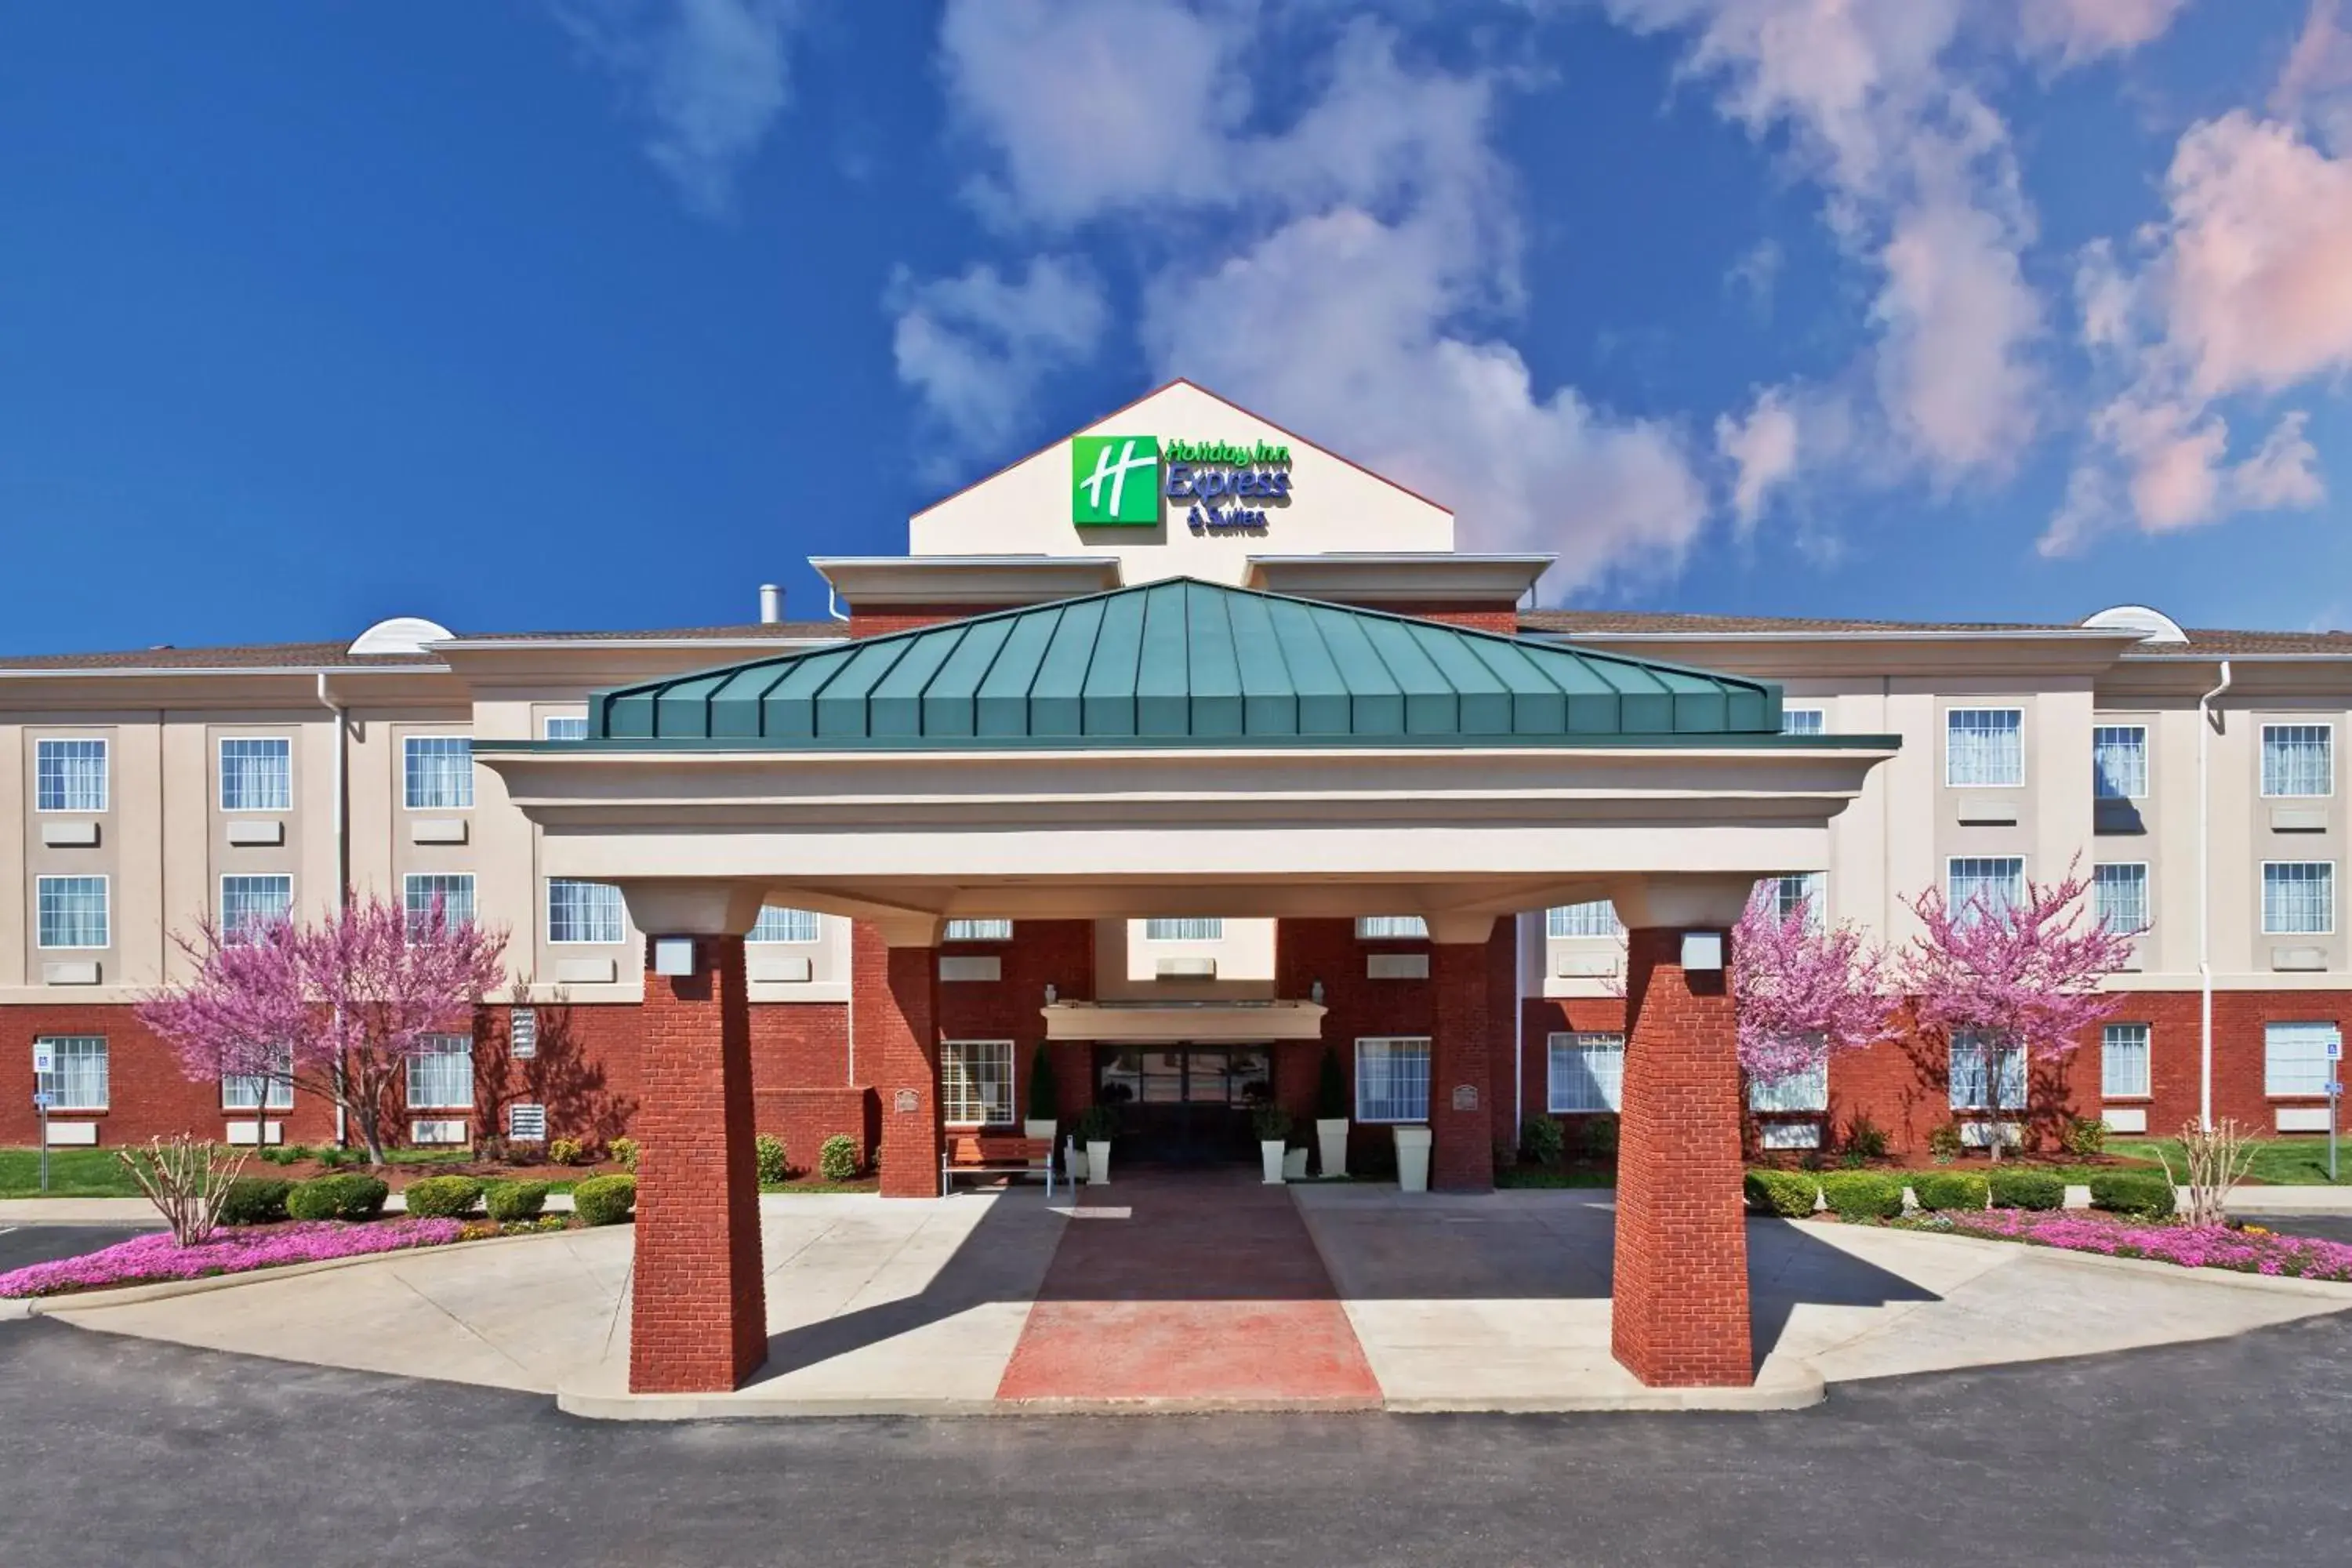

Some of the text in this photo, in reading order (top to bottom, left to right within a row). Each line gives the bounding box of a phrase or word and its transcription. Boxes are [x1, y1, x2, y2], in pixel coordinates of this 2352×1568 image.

[1165, 439, 1289, 466] Holiday Inn
[1167, 463, 1290, 503] Express
[1187, 506, 1268, 526] & Suites
